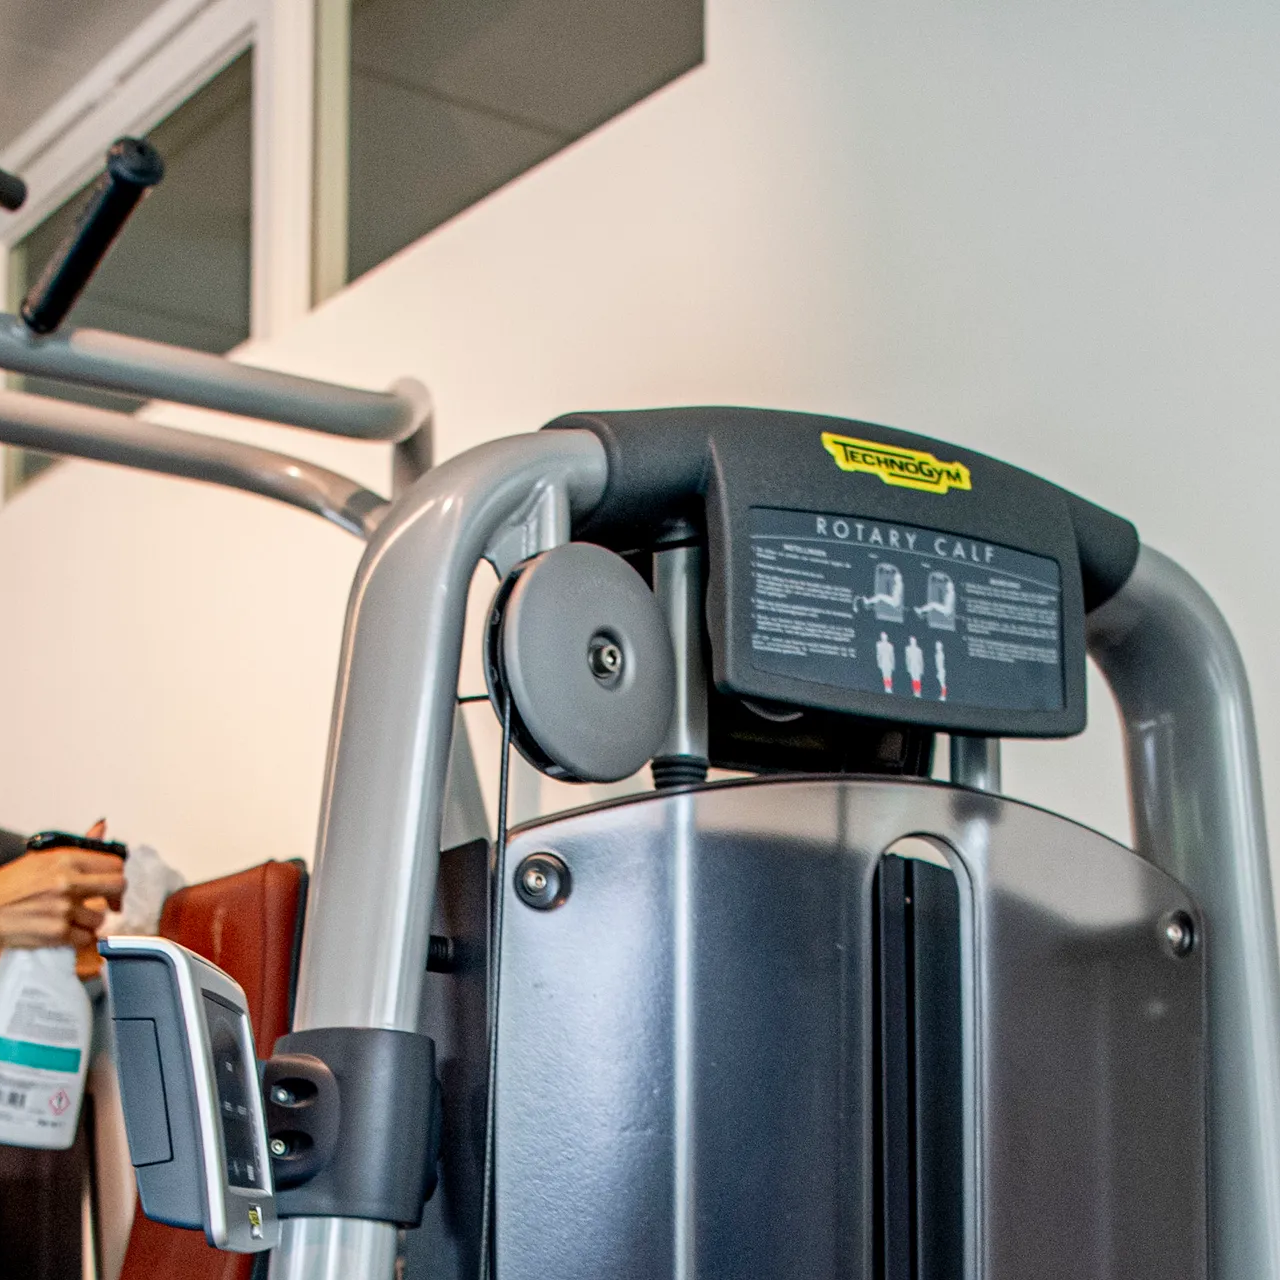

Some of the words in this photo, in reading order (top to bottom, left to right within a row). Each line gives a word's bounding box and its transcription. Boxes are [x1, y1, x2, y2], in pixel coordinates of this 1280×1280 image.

[832, 439, 963, 484] TECHNOGYM
[816, 516, 918, 551] ROTARY
[933, 537, 995, 564] CALF
